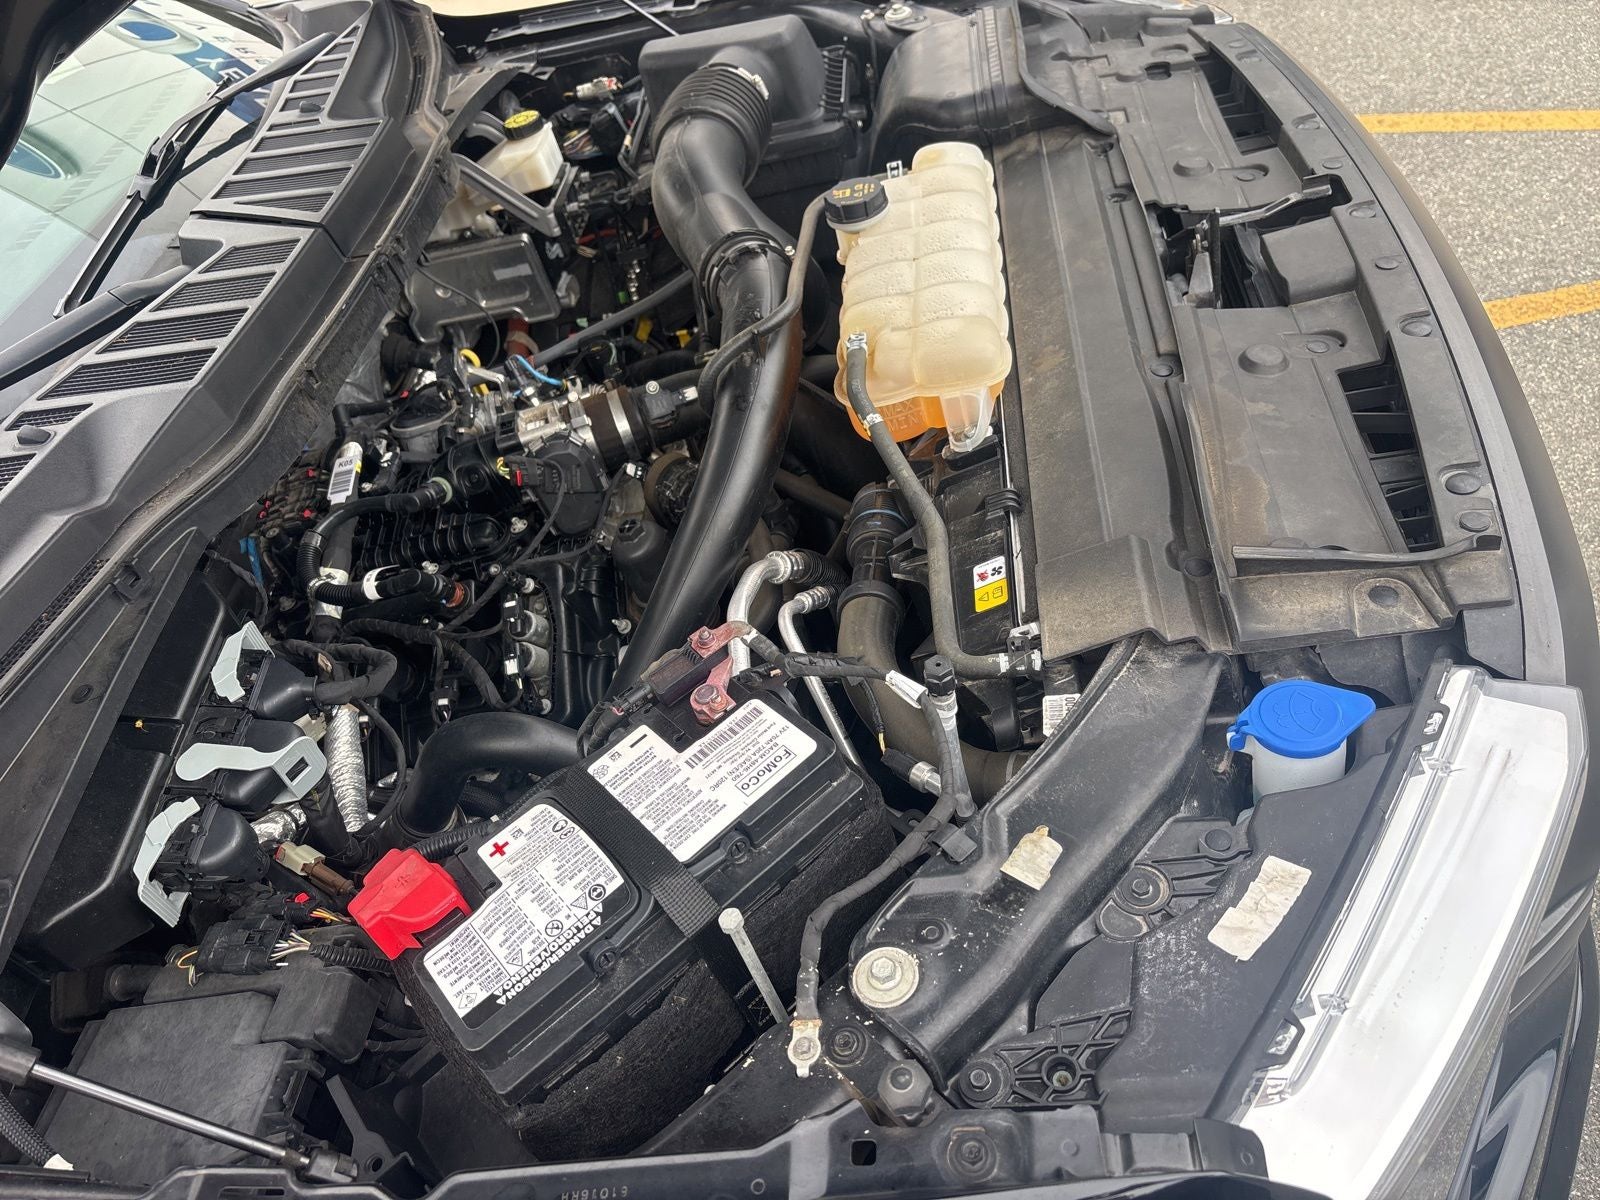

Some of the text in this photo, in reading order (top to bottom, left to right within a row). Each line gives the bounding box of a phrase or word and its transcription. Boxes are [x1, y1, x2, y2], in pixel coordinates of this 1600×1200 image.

[339, 459, 353, 467] K05
[708, 775, 727, 791] 120RC
[739, 748, 792, 792] FoMoCo
[500, 909, 596, 991] PELIGRO/VENENO
[504, 922, 593, 999] DANGER/POISON
